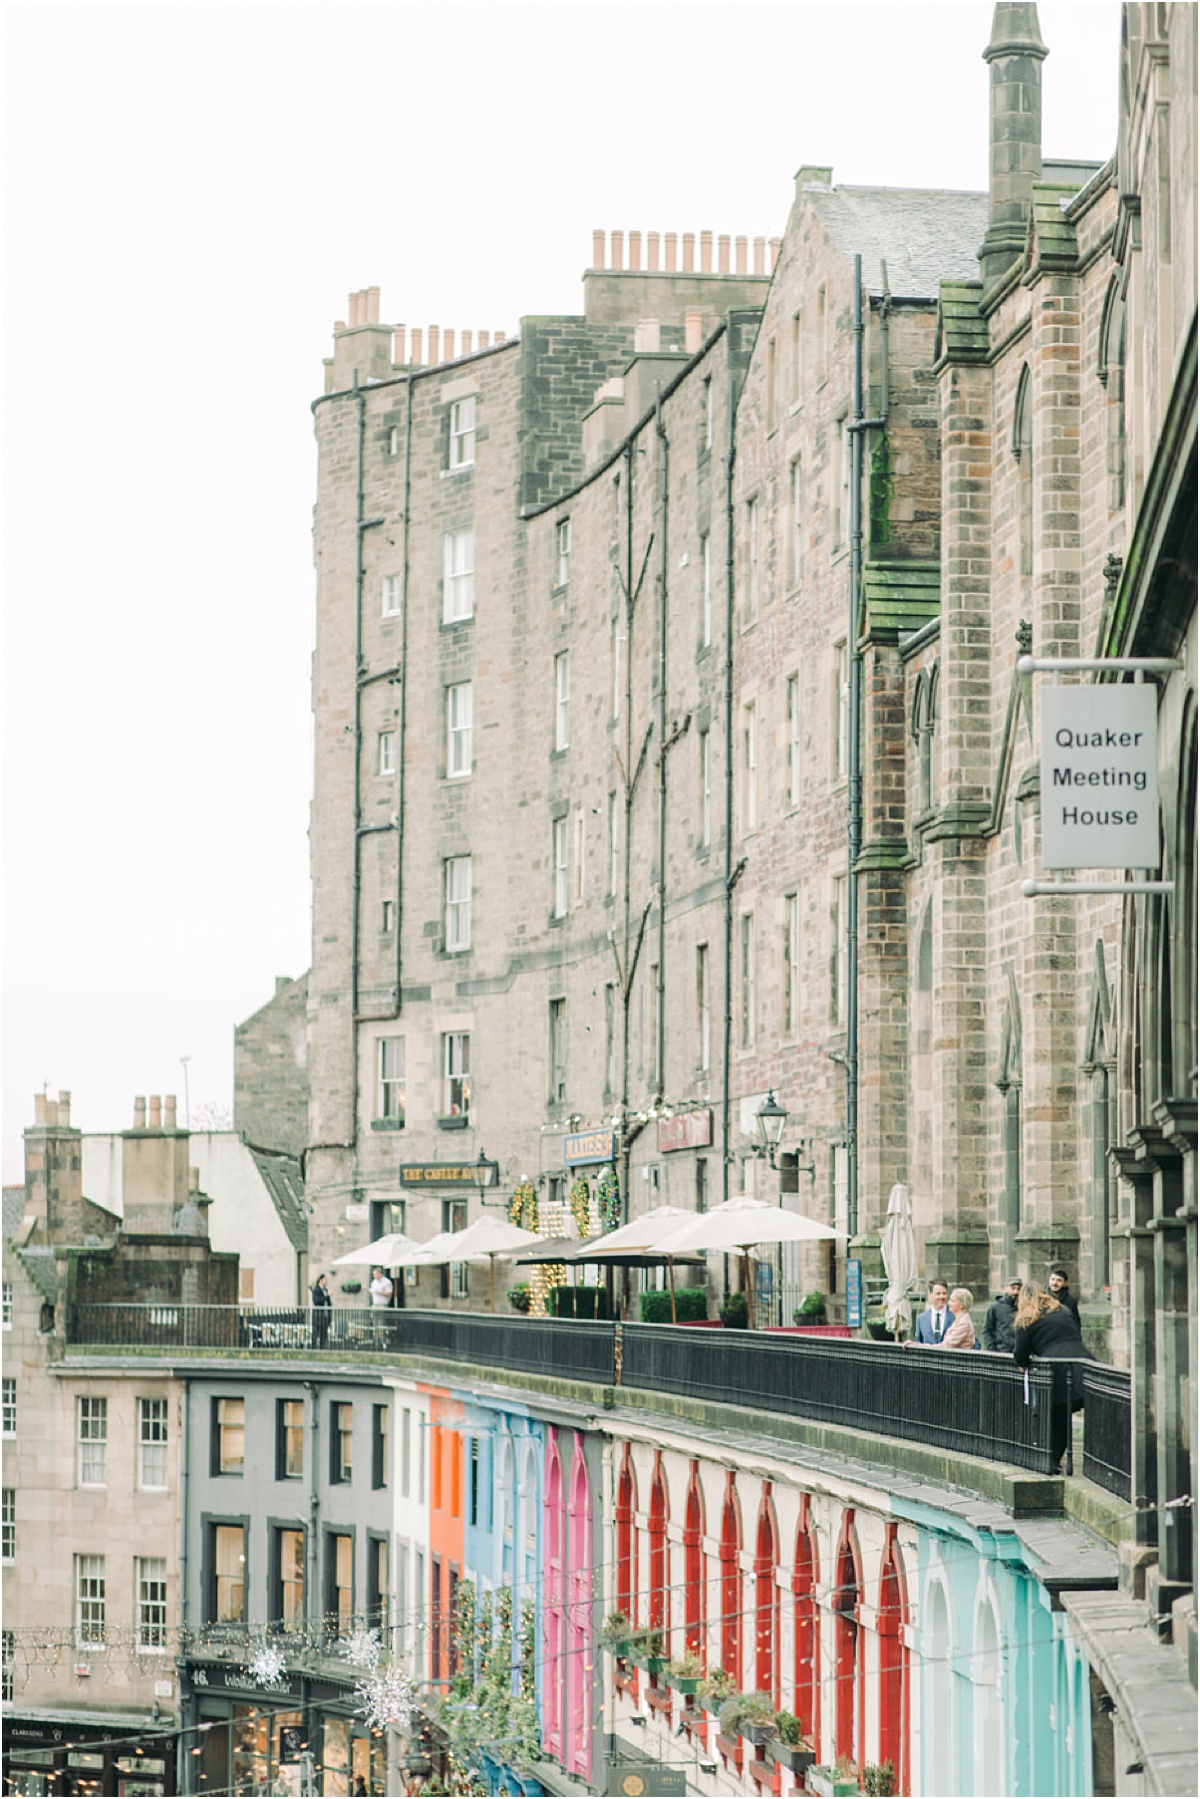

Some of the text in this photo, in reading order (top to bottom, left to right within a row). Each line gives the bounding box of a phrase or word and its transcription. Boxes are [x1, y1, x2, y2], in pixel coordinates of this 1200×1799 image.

[1055, 728, 1143, 749] Quaker
[1053, 768, 1147, 791] Meeting
[1062, 806, 1139, 826] House
[402, 1168, 424, 1181] THE
